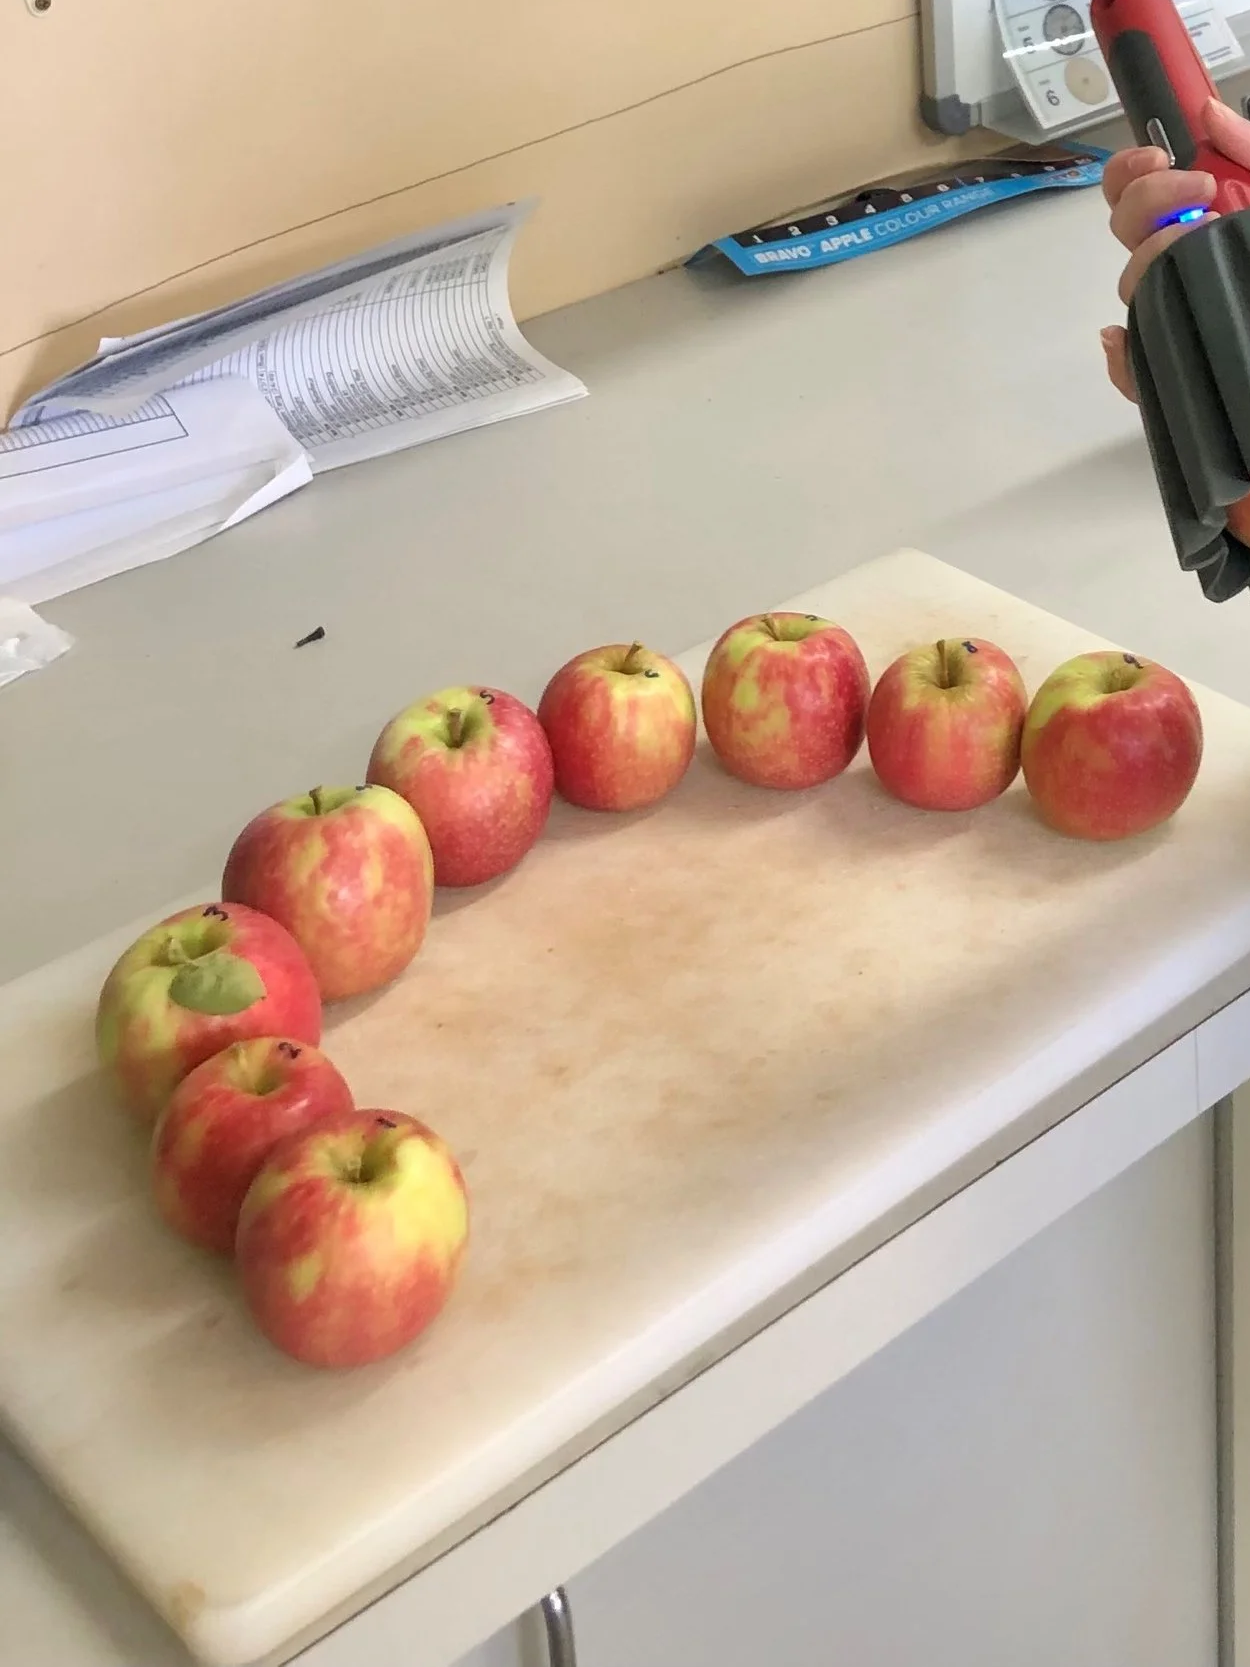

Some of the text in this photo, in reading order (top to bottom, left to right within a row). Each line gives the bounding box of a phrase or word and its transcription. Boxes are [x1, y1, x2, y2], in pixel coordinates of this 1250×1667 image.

[1046, 89, 1060, 106] 6
[752, 234, 764, 244] 1
[787, 225, 802, 236] 2
[864, 203, 877, 214] 4
[820, 227, 874, 253] APPLE
[874, 204, 941, 237] COLOUR
[941, 186, 997, 209] RANGE
